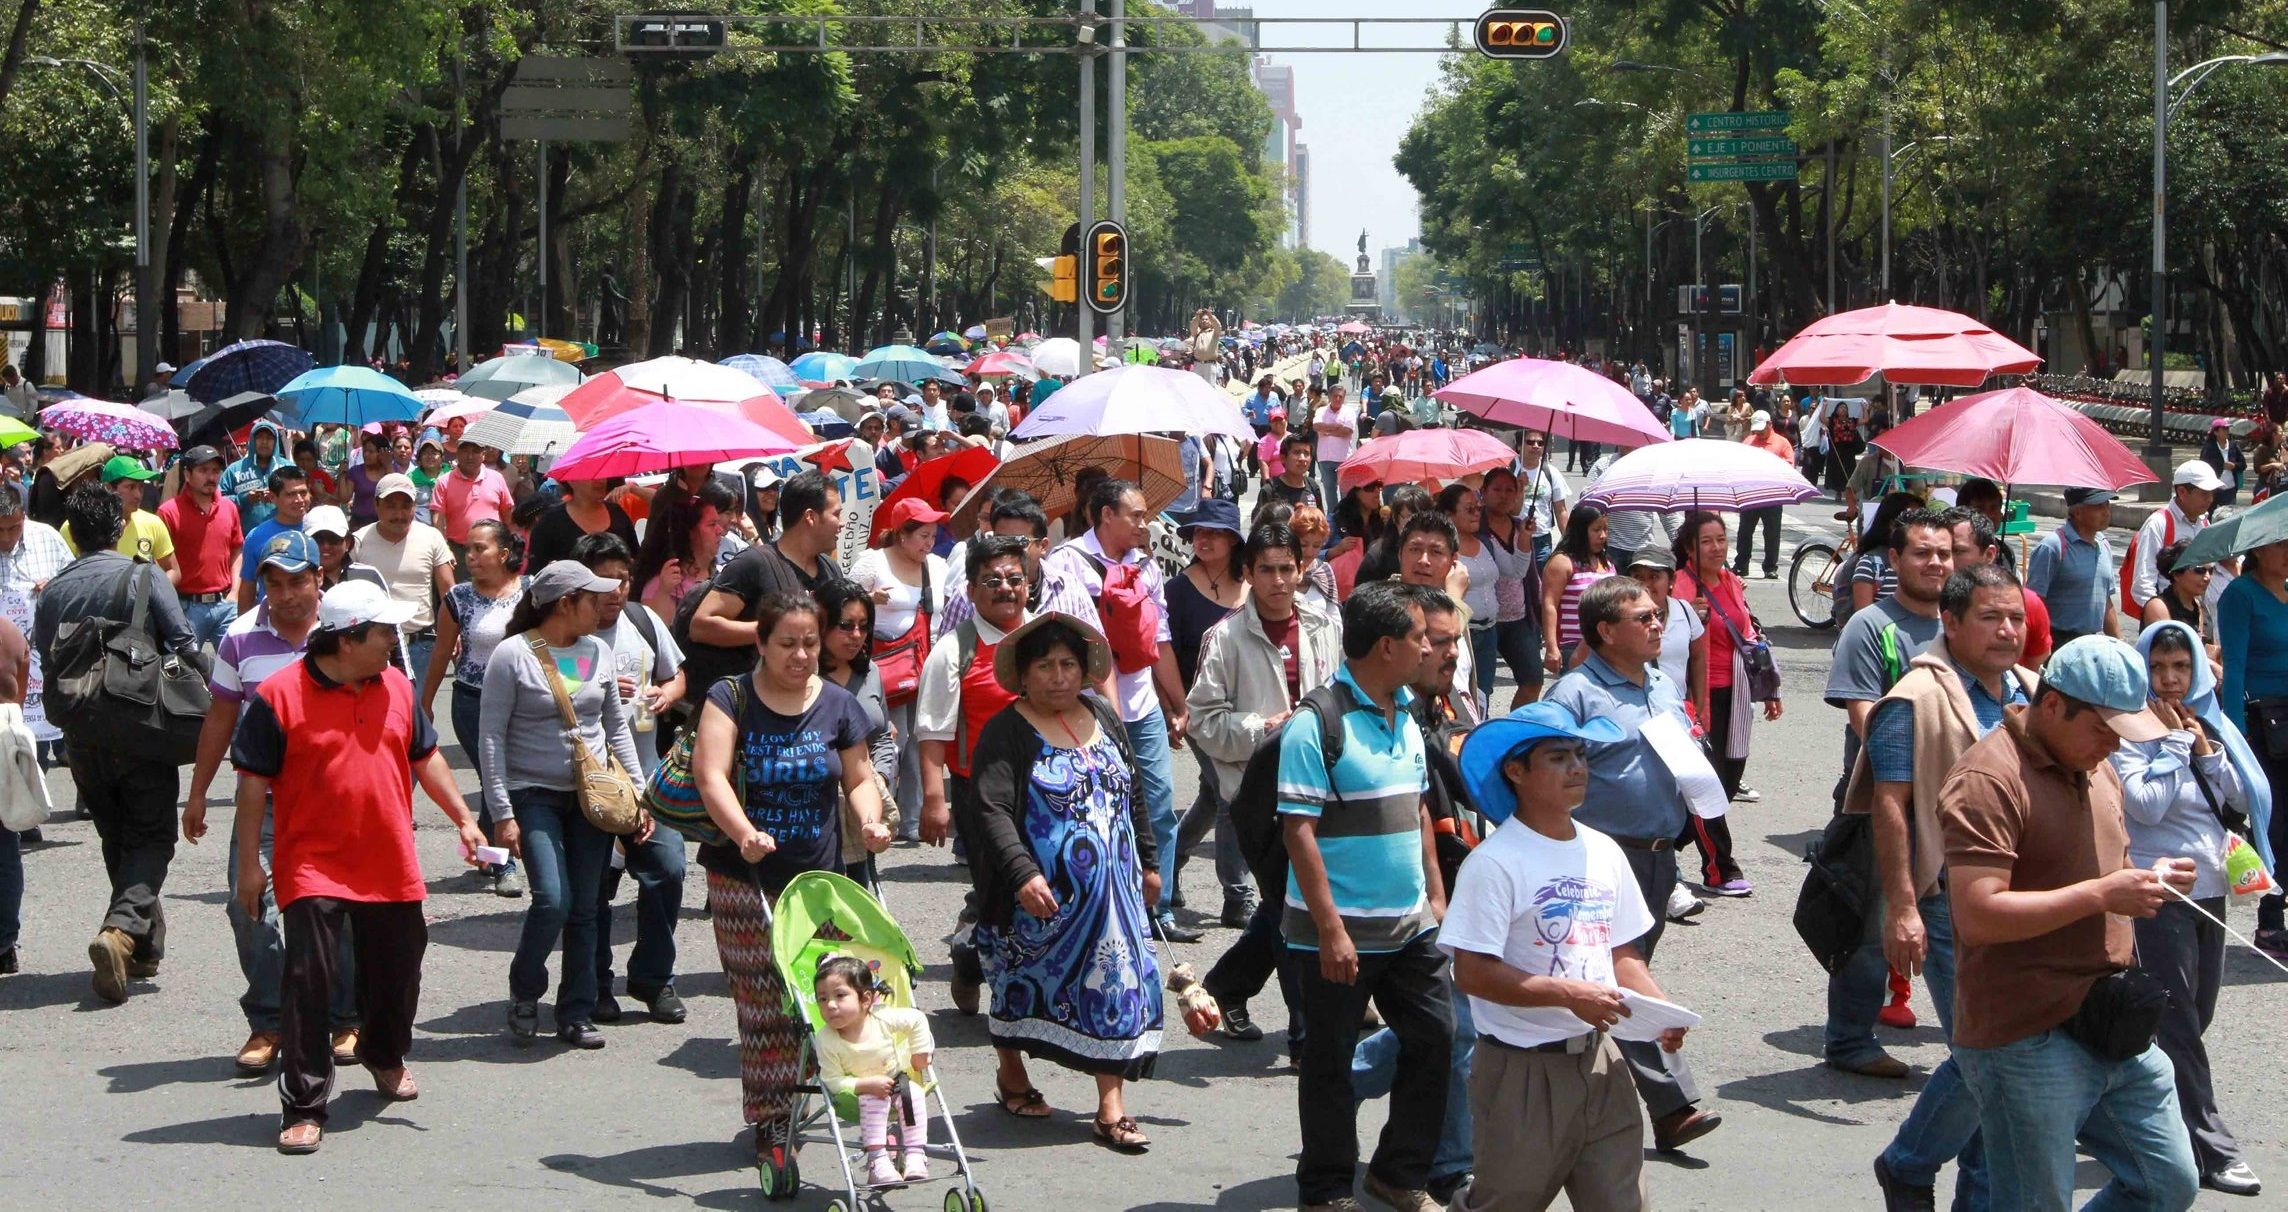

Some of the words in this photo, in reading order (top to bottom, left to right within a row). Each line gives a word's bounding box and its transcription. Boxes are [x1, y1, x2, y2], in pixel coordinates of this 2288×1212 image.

[1707, 116, 1742, 128] CENTRO
[1707, 142, 1726, 153] EJE
[1731, 142, 1736, 152] 1
[1741, 140, 1793, 152] PONIENTE
[1707, 166, 1759, 178] INSURGENTES
[1761, 165, 1793, 177] CENTRO
[747, 732, 754, 741] I
[801, 731, 822, 742] MY
[776, 743, 826, 758] FRIENDS
